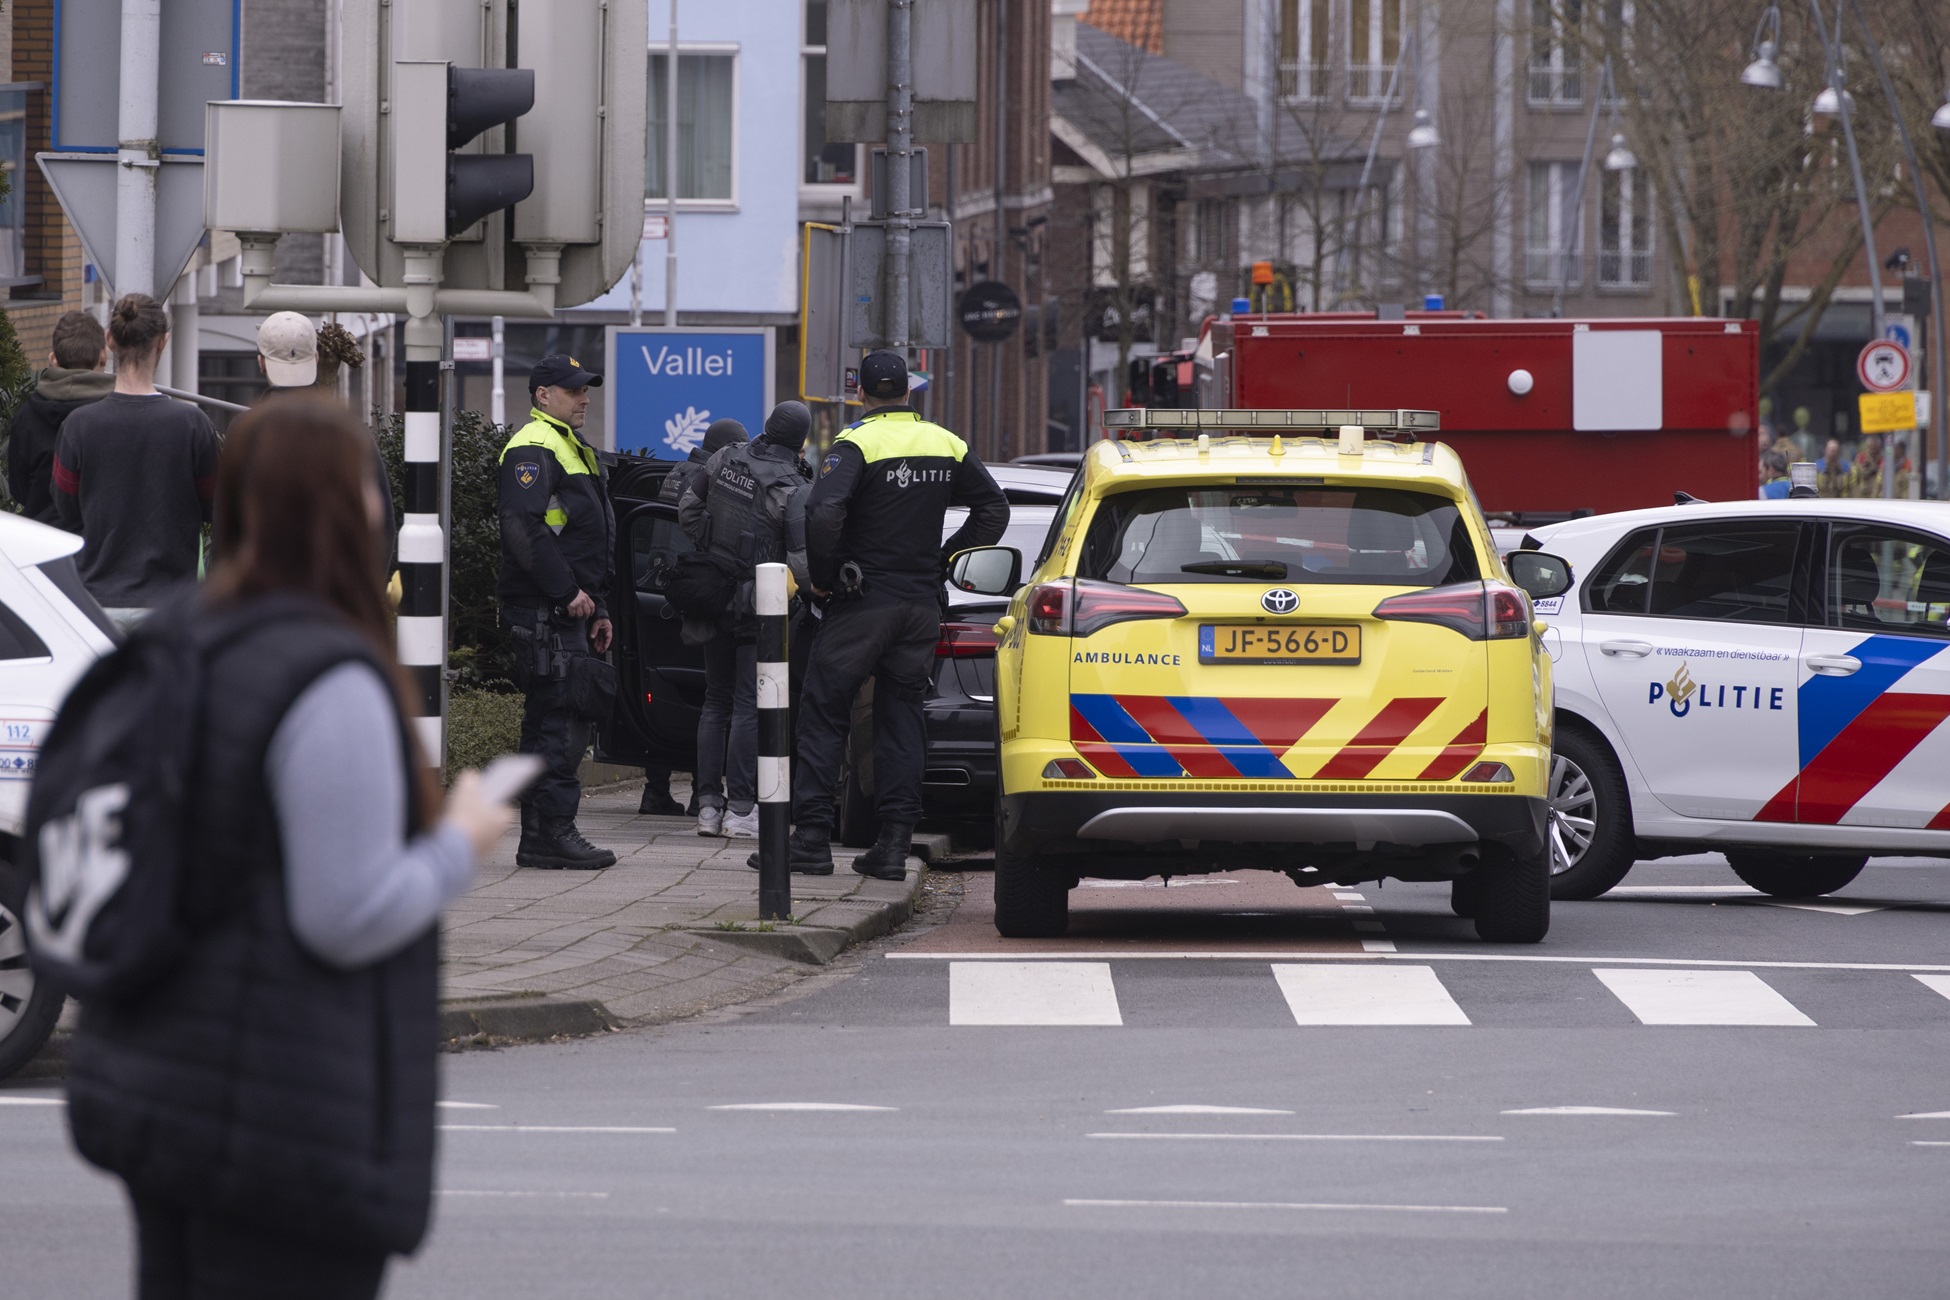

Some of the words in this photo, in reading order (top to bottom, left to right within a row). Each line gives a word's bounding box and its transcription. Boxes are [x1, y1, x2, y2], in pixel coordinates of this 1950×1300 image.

[641, 345, 733, 376] Vallei
[720, 467, 755, 491] POLITIE
[886, 470, 952, 488] POLITIE
[1202, 644, 1213, 652] NL
[1225, 630, 1349, 653] JF-566-D
[1073, 652, 1181, 666] AMBULANCE
[1664, 647, 1716, 659] waakzaam
[1717, 650, 1729, 659] en
[1730, 649, 1782, 661] dienstbaar
[1648, 680, 1784, 718] POLITIE
[7, 725, 31, 738] 112
